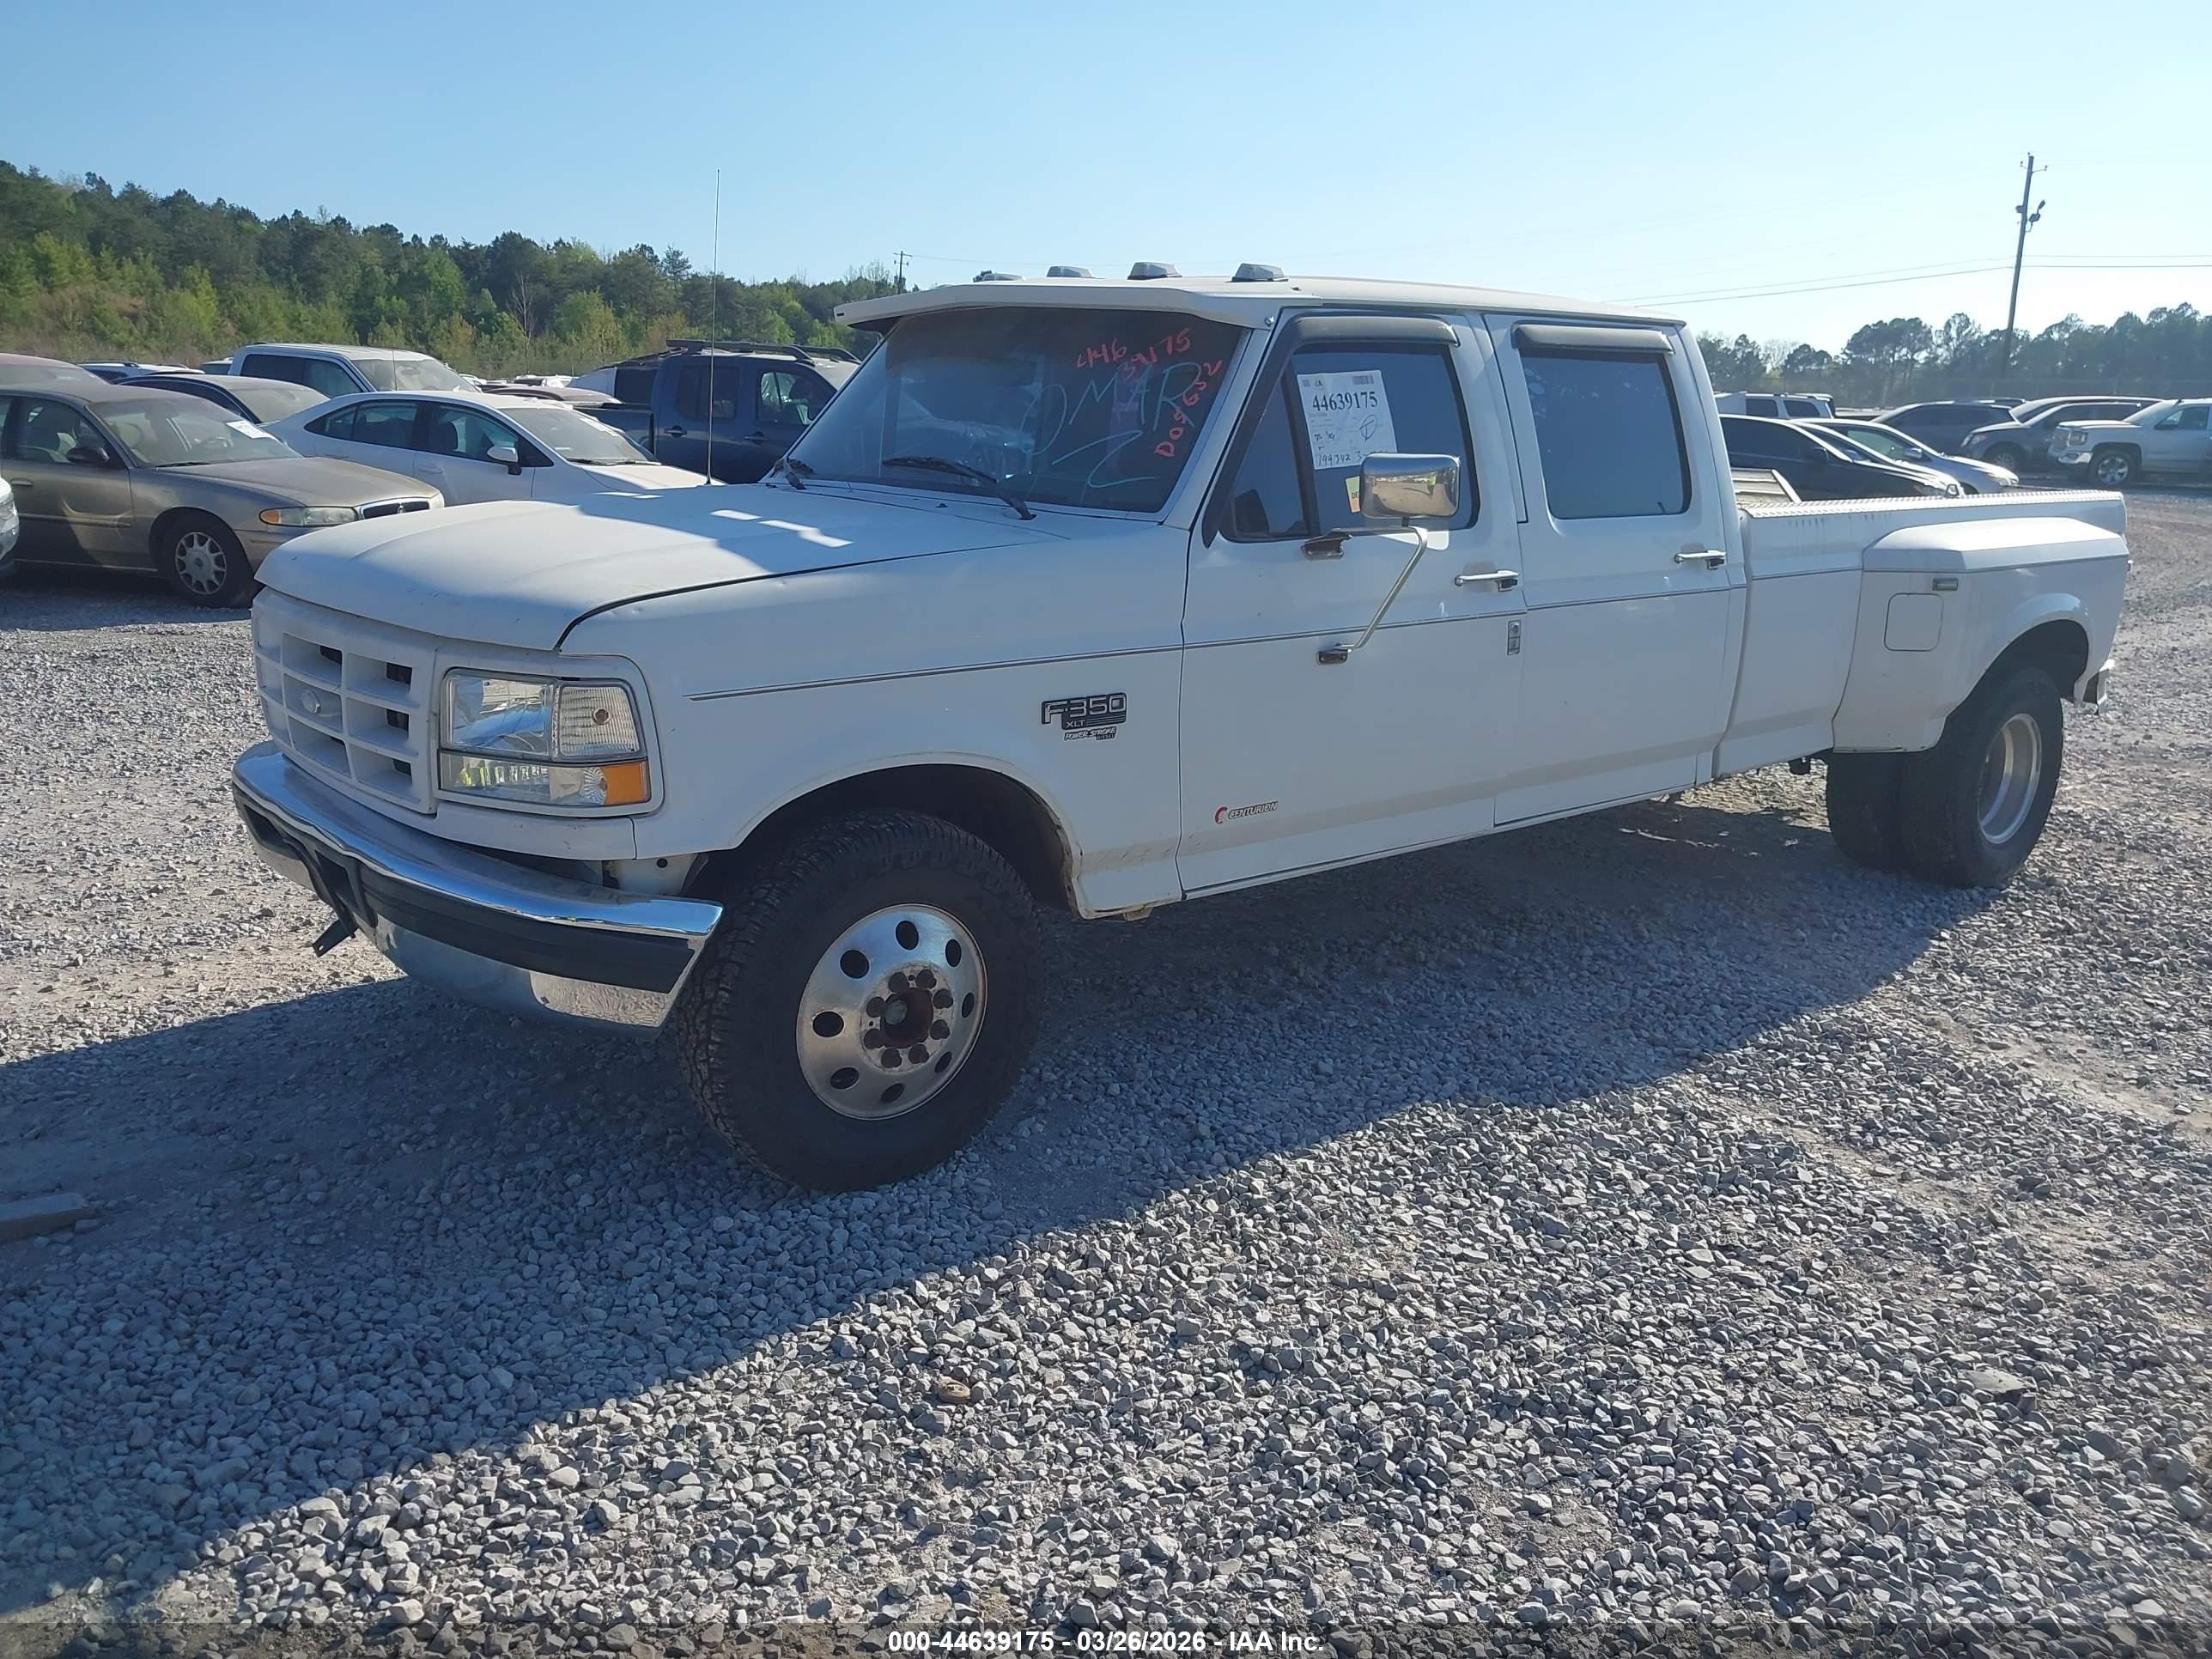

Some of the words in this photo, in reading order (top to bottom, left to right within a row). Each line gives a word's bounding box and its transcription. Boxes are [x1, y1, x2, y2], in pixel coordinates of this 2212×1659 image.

[1312, 391, 1378, 411] 44639175
[1066, 720, 1085, 729] XLT
[1228, 800, 1278, 820] CENTURION
